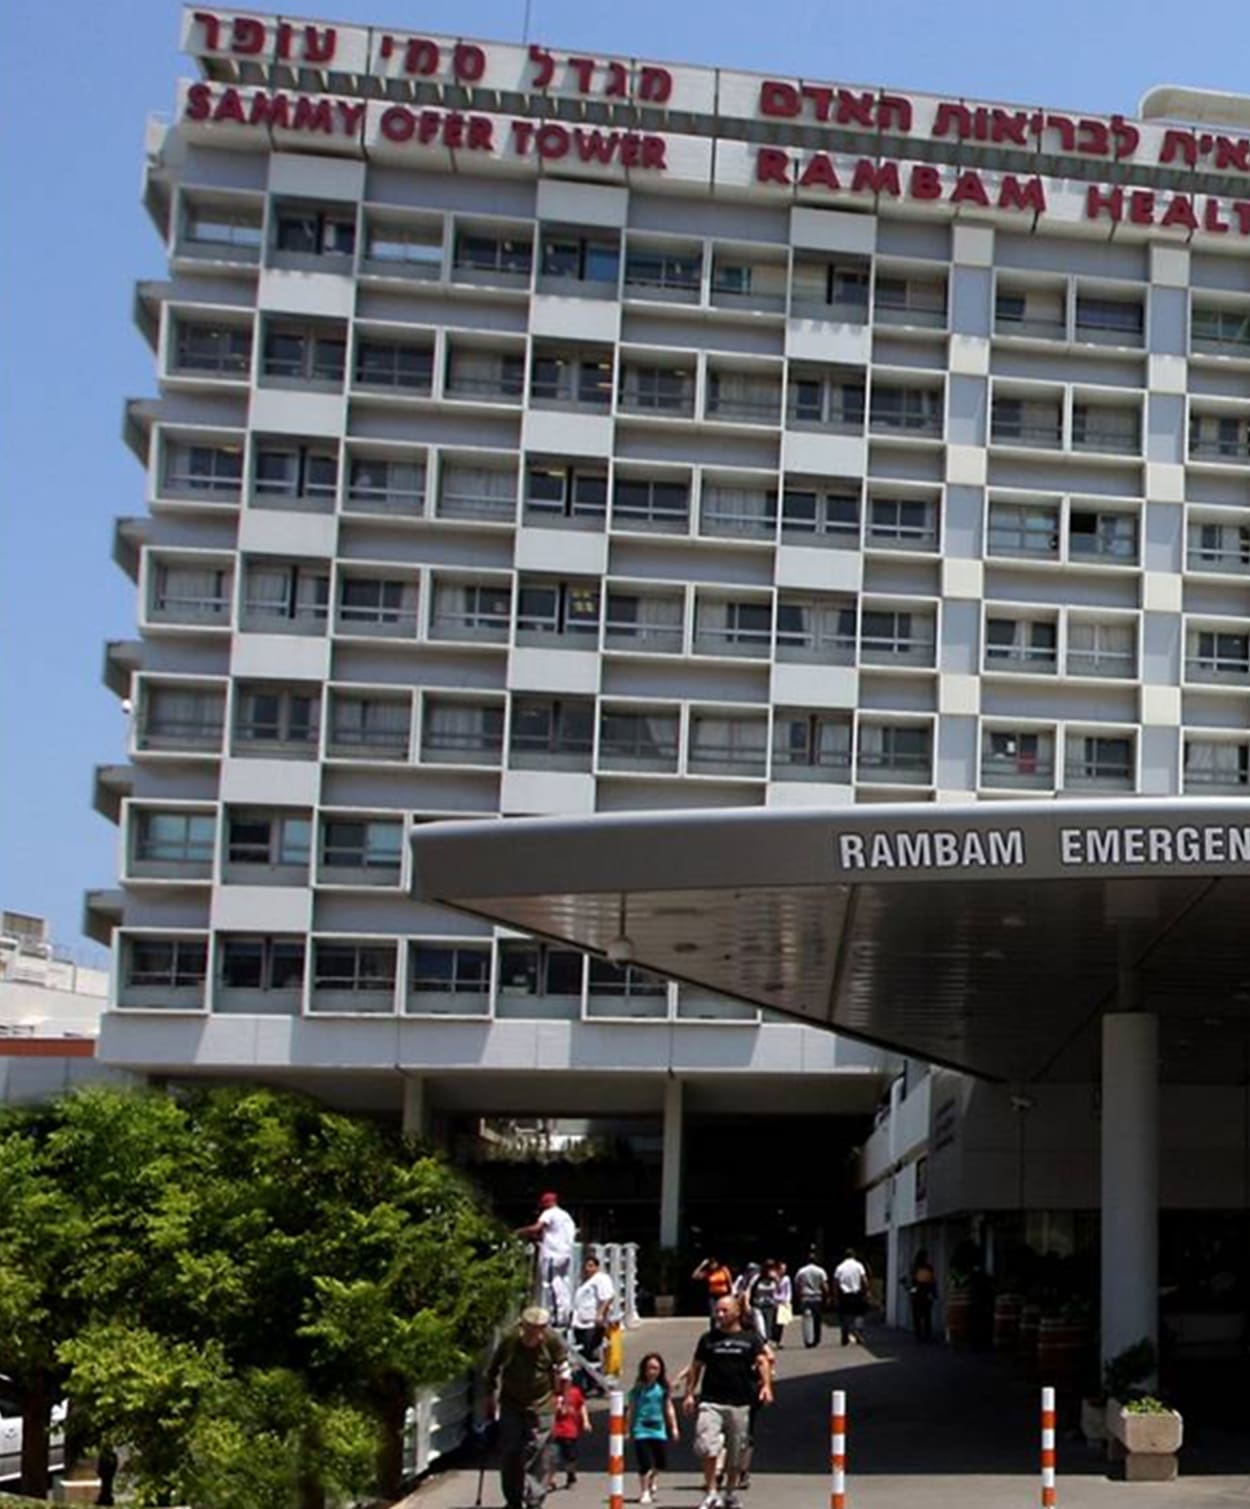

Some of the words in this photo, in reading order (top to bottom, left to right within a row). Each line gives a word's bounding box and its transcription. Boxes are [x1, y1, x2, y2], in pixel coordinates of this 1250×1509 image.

[194, 12, 337, 63] עופר
[380, 35, 486, 83] סמי
[527, 43, 674, 103] מגדל
[183, 83, 365, 138] SAMMY
[379, 105, 494, 154] OFER
[511, 120, 668, 172] TOWER
[759, 81, 913, 132] האדם
[932, 101, 1140, 158] לבריאות
[756, 148, 1047, 214] RAMBAM
[839, 830, 1024, 869] RAMBAM
